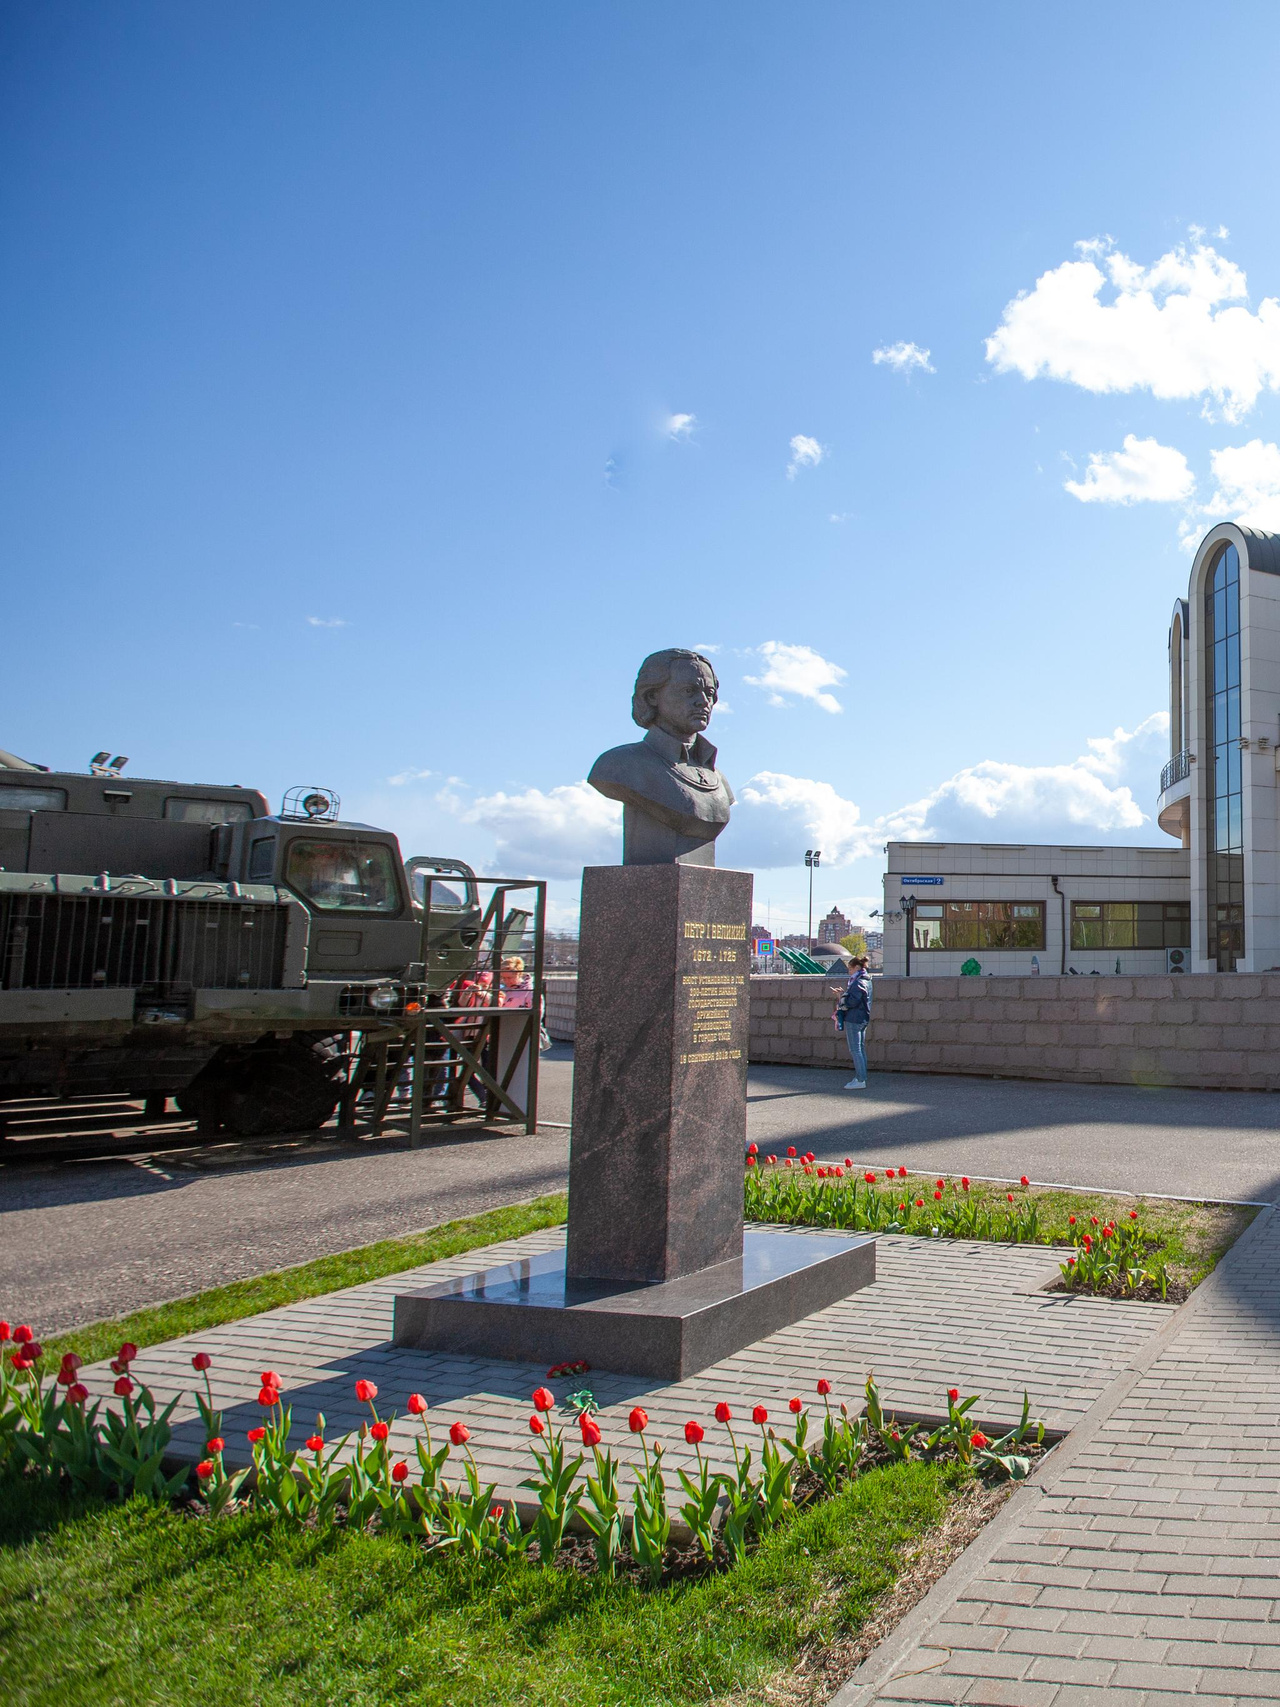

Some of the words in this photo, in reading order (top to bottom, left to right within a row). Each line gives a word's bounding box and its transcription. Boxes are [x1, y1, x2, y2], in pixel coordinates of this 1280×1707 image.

[684, 922, 705, 939] ПЕТР
[711, 922, 746, 940] ВЕЛИКИЙ
[693, 950, 712, 962] 1672
[719, 950, 737, 962] 1725
